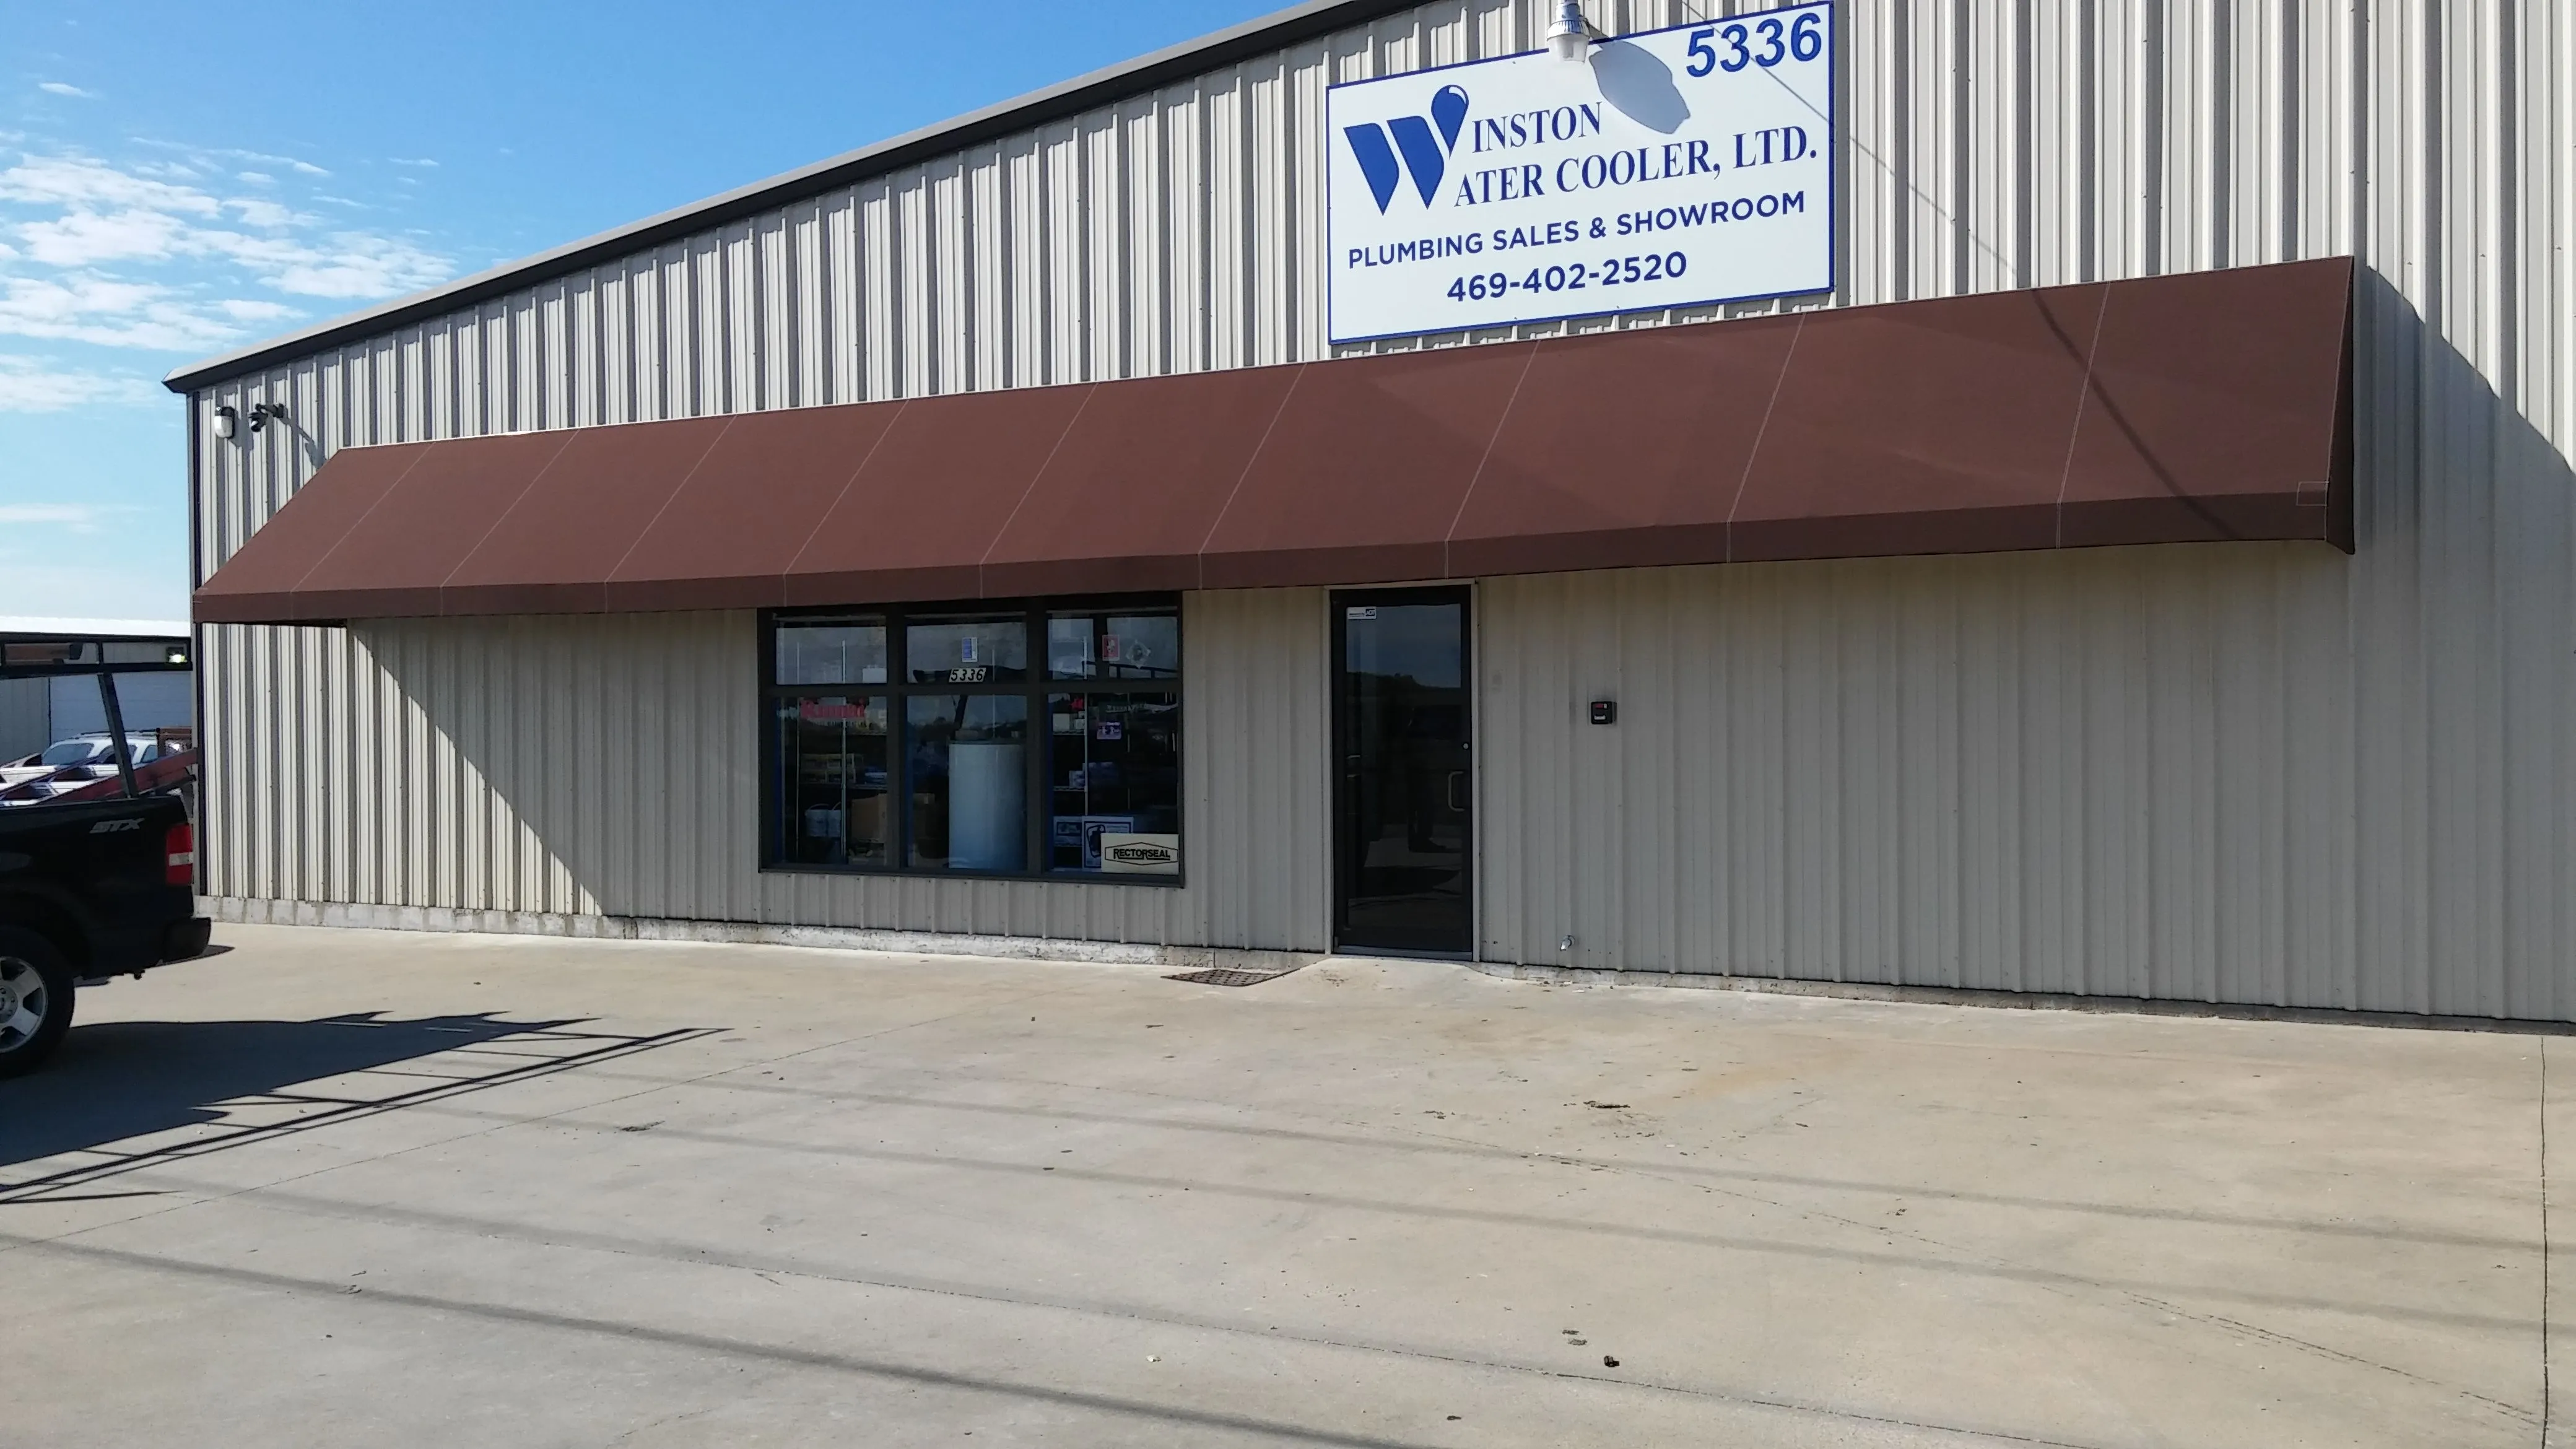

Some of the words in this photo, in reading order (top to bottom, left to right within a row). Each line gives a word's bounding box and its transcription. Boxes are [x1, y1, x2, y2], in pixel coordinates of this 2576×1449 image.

[1686, 12, 1822, 77] 5336
[1556, 139, 1721, 193] COOLER,
[1733, 126, 1817, 169] LTD.
[1349, 233, 1483, 269] PLUMBING
[1493, 220, 1579, 250] SALES
[1589, 217, 1607, 239] &
[1617, 190, 1804, 235] SHOWROOM
[1447, 251, 1687, 302] 469-402-2520
[951, 669, 984, 681] 5336
[89, 817, 145, 833] STX
[1113, 848, 1171, 860] RECTORSEAL
